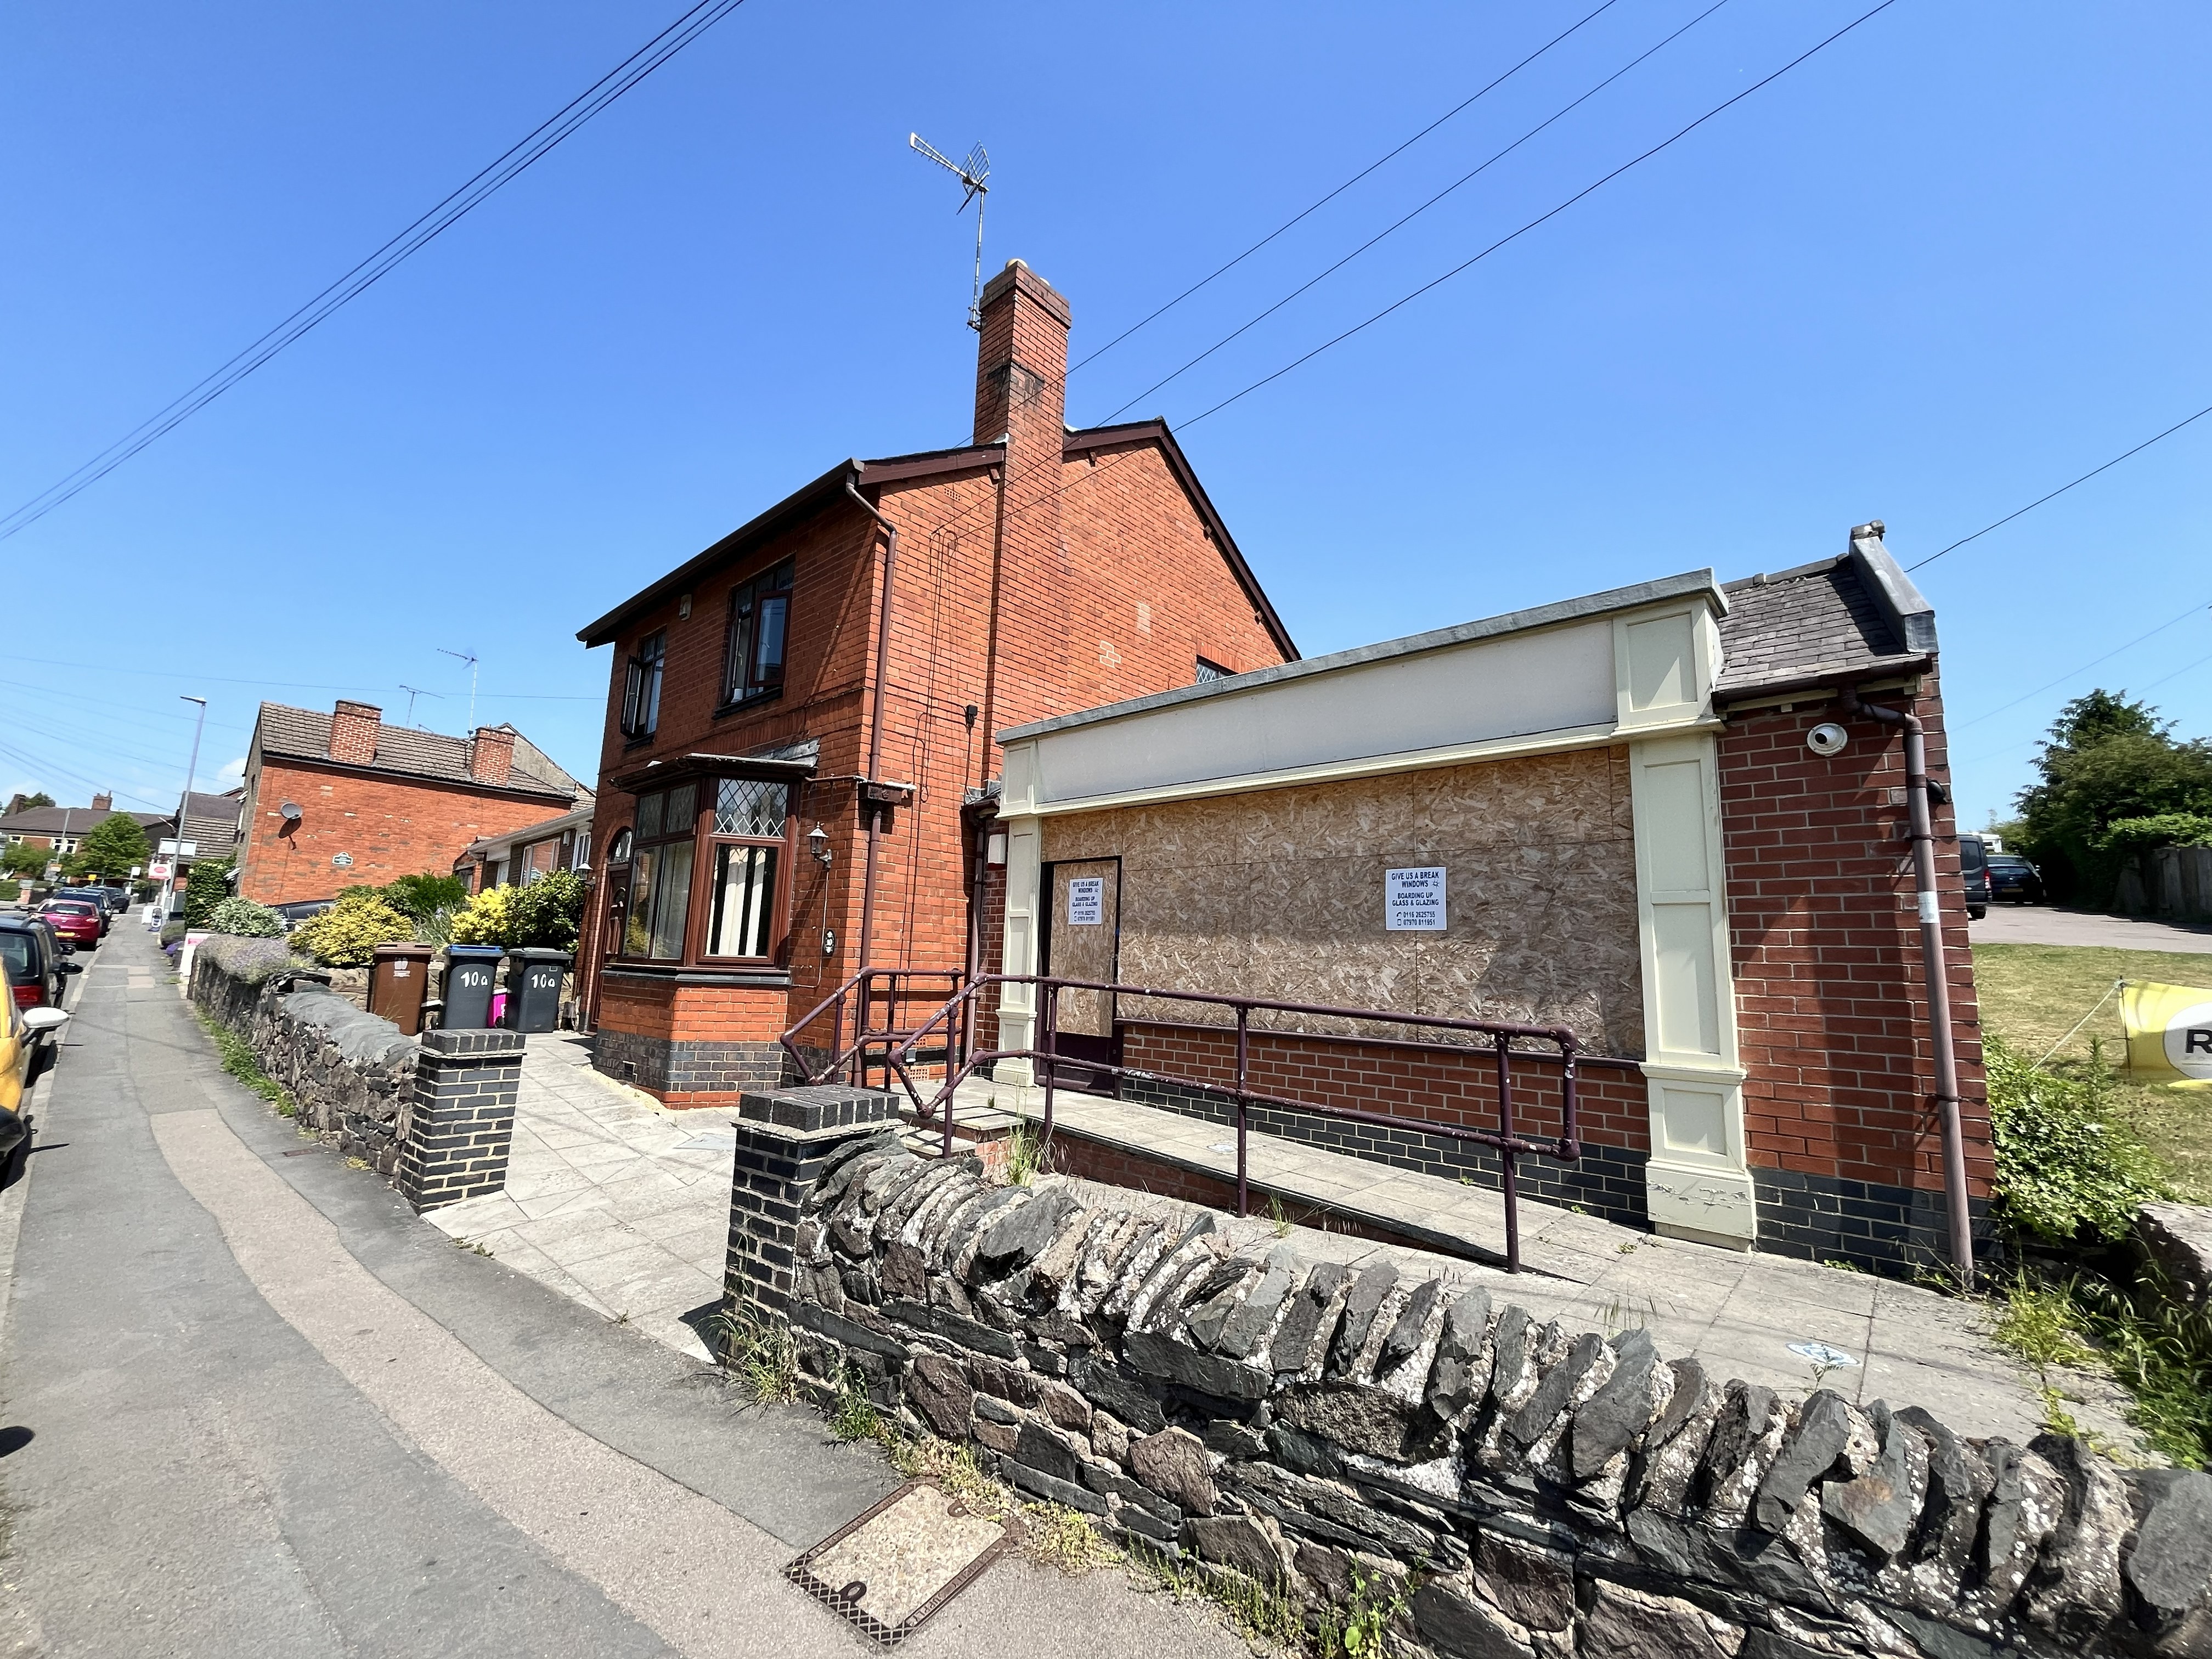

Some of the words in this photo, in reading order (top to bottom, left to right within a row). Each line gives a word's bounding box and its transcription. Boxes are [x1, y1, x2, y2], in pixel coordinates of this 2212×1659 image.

[460, 971, 488, 988] 10a
[531, 973, 555, 988] 10a
[912, 1591, 947, 1622] SUPPLY
